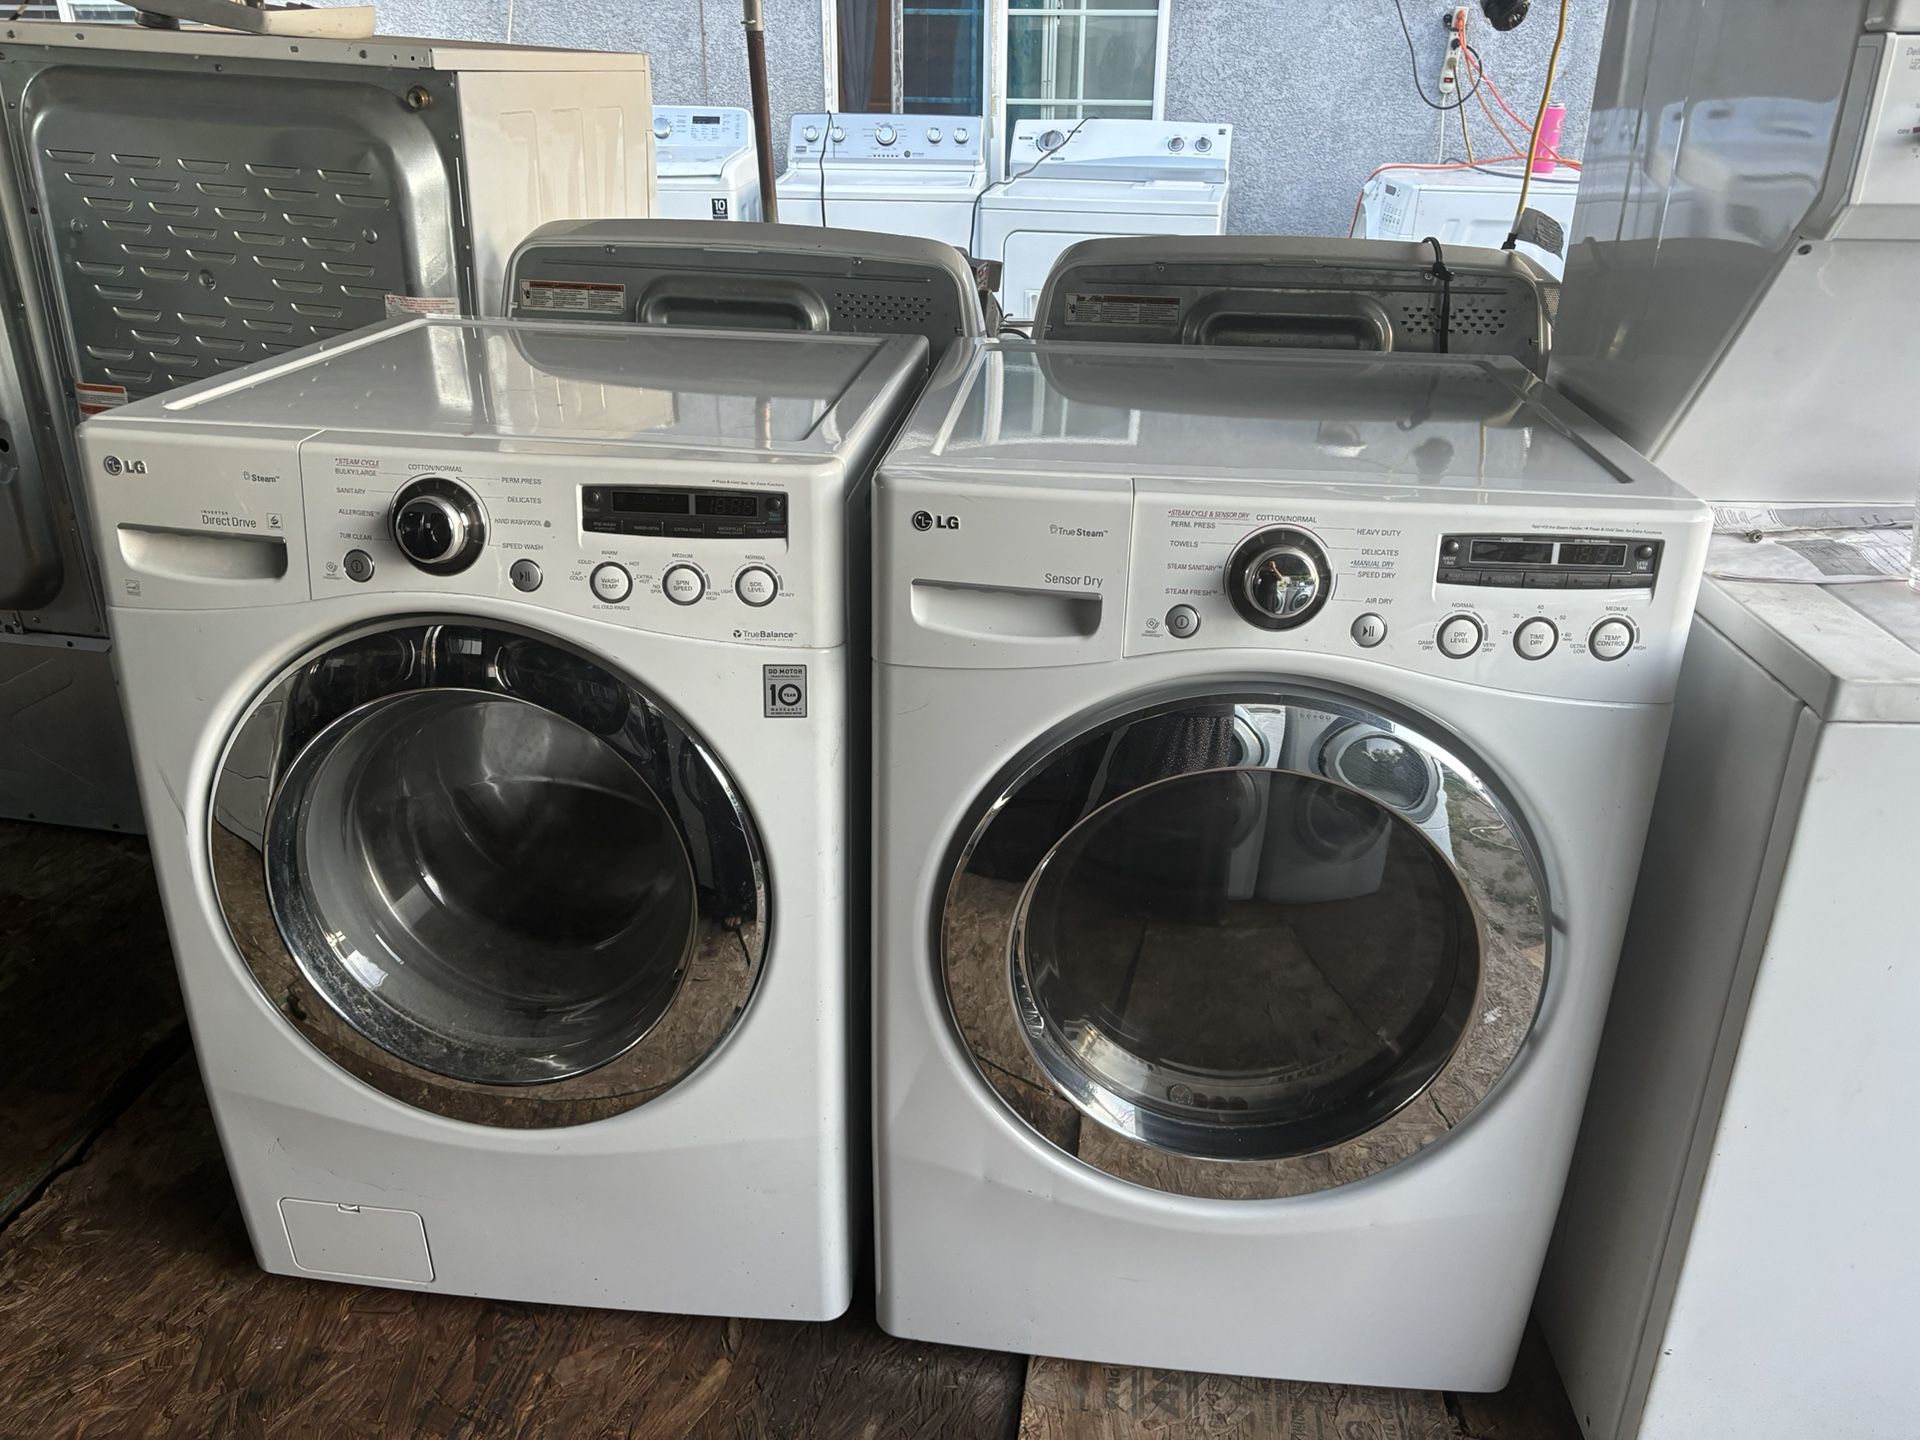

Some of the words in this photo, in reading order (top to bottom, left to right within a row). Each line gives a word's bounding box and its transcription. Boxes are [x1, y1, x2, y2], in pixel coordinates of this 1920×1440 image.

[714, 200, 726, 211] 10
[125, 459, 148, 474] LG
[360, 459, 379, 467] CYCLE
[335, 468, 377, 477] BULKY/LARGE
[407, 463, 463, 473] COTTON/NORMAL
[336, 487, 366, 495] SANITARY
[507, 496, 542, 505] DELICATES
[1190, 510, 1208, 518] CYCLE
[1214, 511, 1236, 519] SENSOR
[1256, 513, 1318, 524] COTTON/NORMAL
[202, 514, 231, 527] Direct
[232, 516, 257, 528] Drive
[936, 515, 960, 530] LG
[1193, 521, 1216, 529] PRESS
[1356, 528, 1381, 536] HEAVY
[352, 533, 373, 541] CLEAN
[523, 543, 544, 551] WASH
[1169, 540, 1199, 548] TOWELS
[1361, 548, 1400, 557] DELICATES
[1167, 563, 1188, 571] STEAM
[1044, 573, 1082, 585] Sensor
[1083, 575, 1104, 589] Dry
[1165, 587, 1190, 596] STEAM
[769, 683, 803, 707] 10
